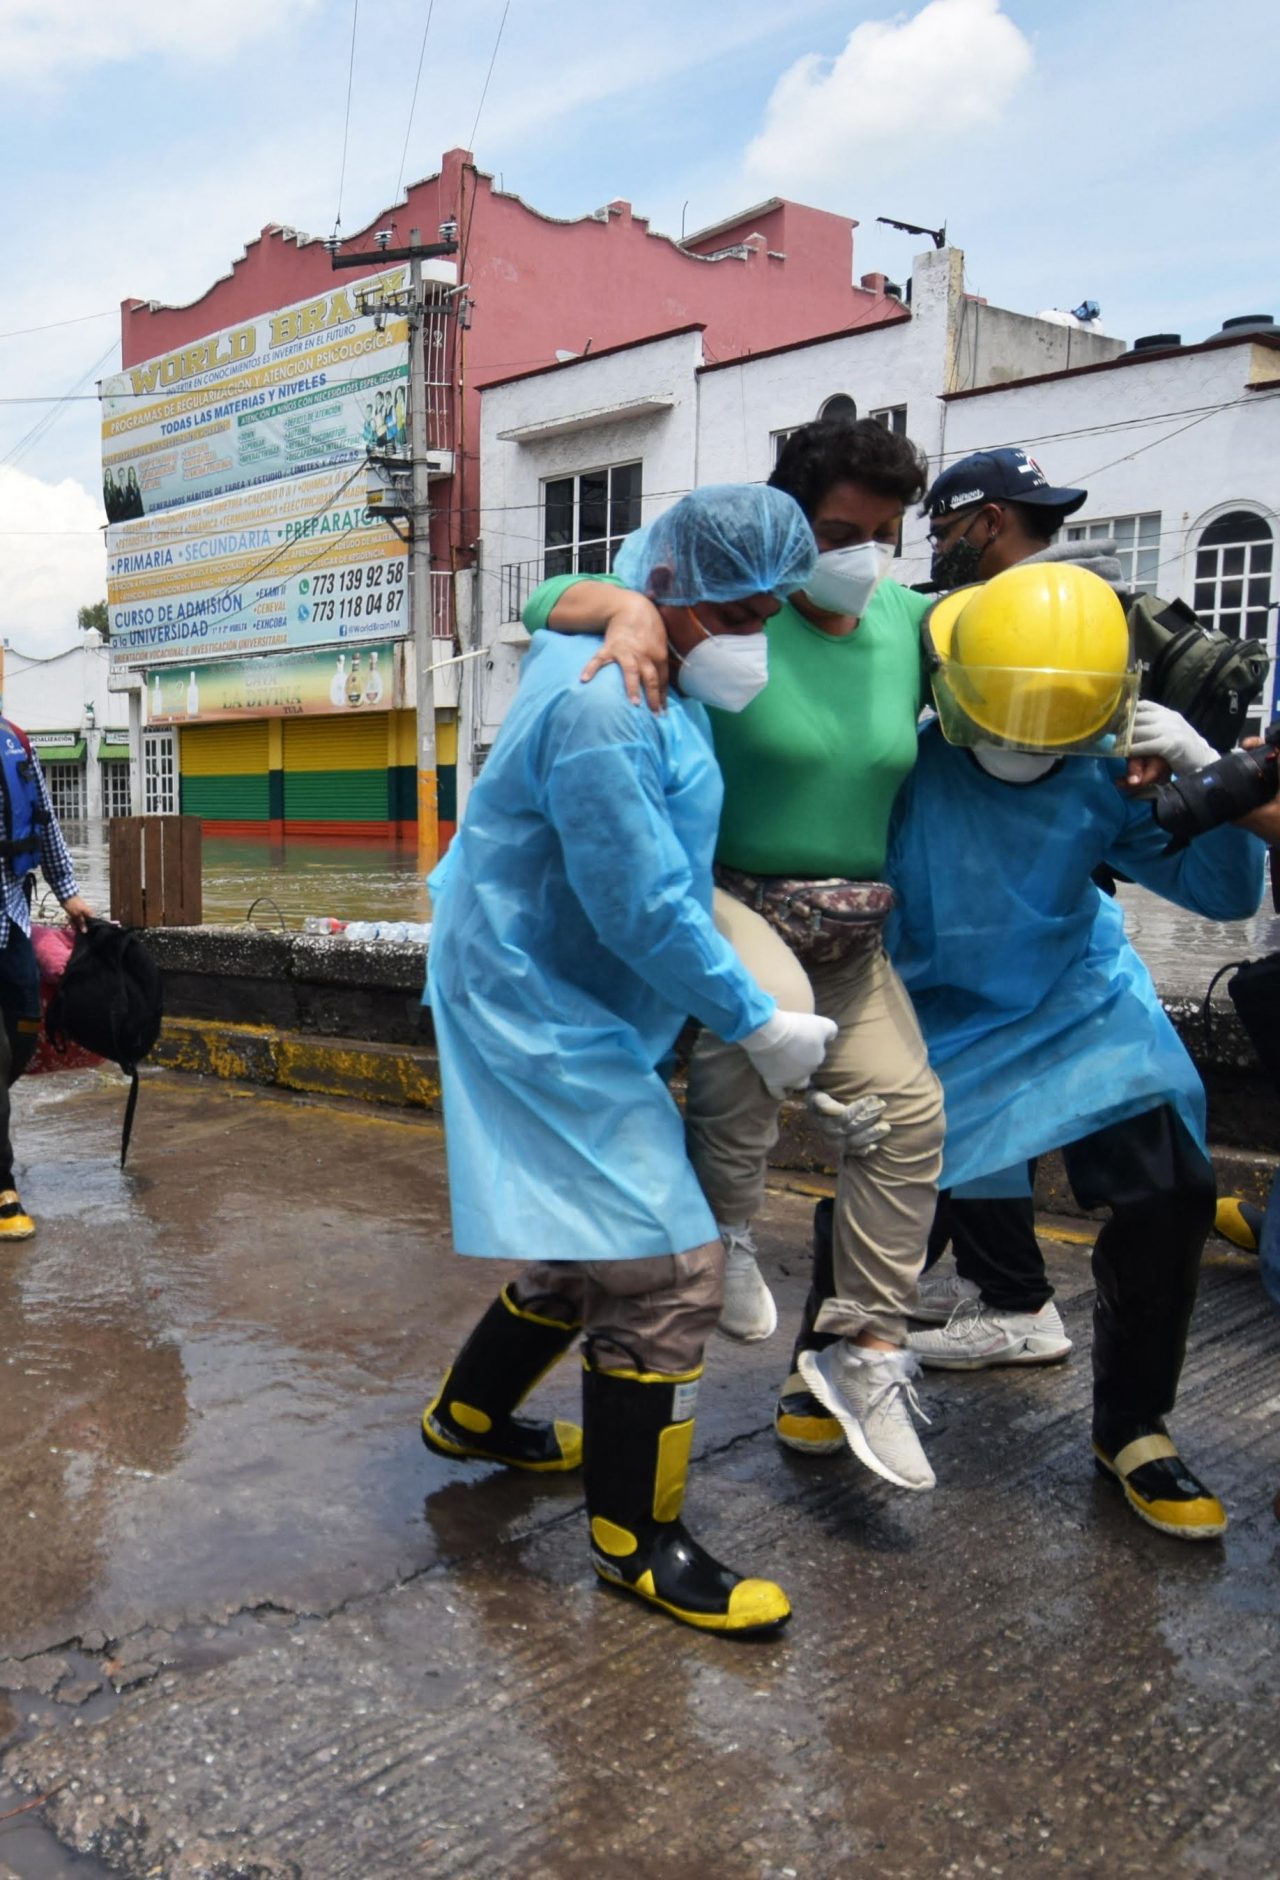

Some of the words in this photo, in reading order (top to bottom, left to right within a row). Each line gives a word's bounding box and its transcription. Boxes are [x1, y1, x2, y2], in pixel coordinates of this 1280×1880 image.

[129, 325, 256, 397] WORLD
[166, 381, 193, 398] INVERTIR
[194, 376, 202, 388] EN
[203, 357, 261, 385] CONOCIMIENTOS
[262, 352, 271, 365] ES
[272, 342, 303, 361] INVERTIR
[304, 337, 314, 350] EN
[315, 333, 323, 346] EL
[325, 323, 355, 343] FUTURO
[111, 407, 162, 434] PROGRAMAS
[164, 403, 175, 417] DE
[254, 374, 259, 388] Y
[160, 416, 191, 436] TODAS
[194, 409, 211, 426] LAS
[213, 392, 265, 420] MATERIAS
[268, 389, 275, 403] Y
[277, 373, 326, 400] NIVELES
[271, 407, 275, 416] A
[297, 396, 312, 408] CON
[314, 383, 357, 403] NECESIDADES
[214, 485, 223, 495] DE
[224, 479, 245, 493] TAREA
[247, 478, 251, 487] Y
[253, 471, 282, 486] ESTUDIO
[116, 548, 173, 574] PRIMARIA
[185, 528, 269, 561] SECUNDARIA
[311, 573, 335, 597] 773
[338, 569, 362, 593] 139
[366, 565, 383, 588] 92
[385, 561, 403, 584] 58
[114, 608, 153, 628] CURSO
[159, 605, 172, 622] DE
[176, 589, 242, 619] ADMISIÓN
[256, 616, 287, 630] EXHCOBA
[311, 600, 335, 623] 773
[338, 596, 362, 619] 118
[365, 593, 382, 615] 04
[385, 589, 403, 612] 87
[112, 639, 118, 647] a
[119, 636, 128, 646] la
[129, 620, 208, 645] UNIVERSIDAD
[238, 634, 287, 649] UNIVERSITARIA
[348, 619, 401, 635] @WorldBrainTM
[282, 705, 304, 714] TULA
